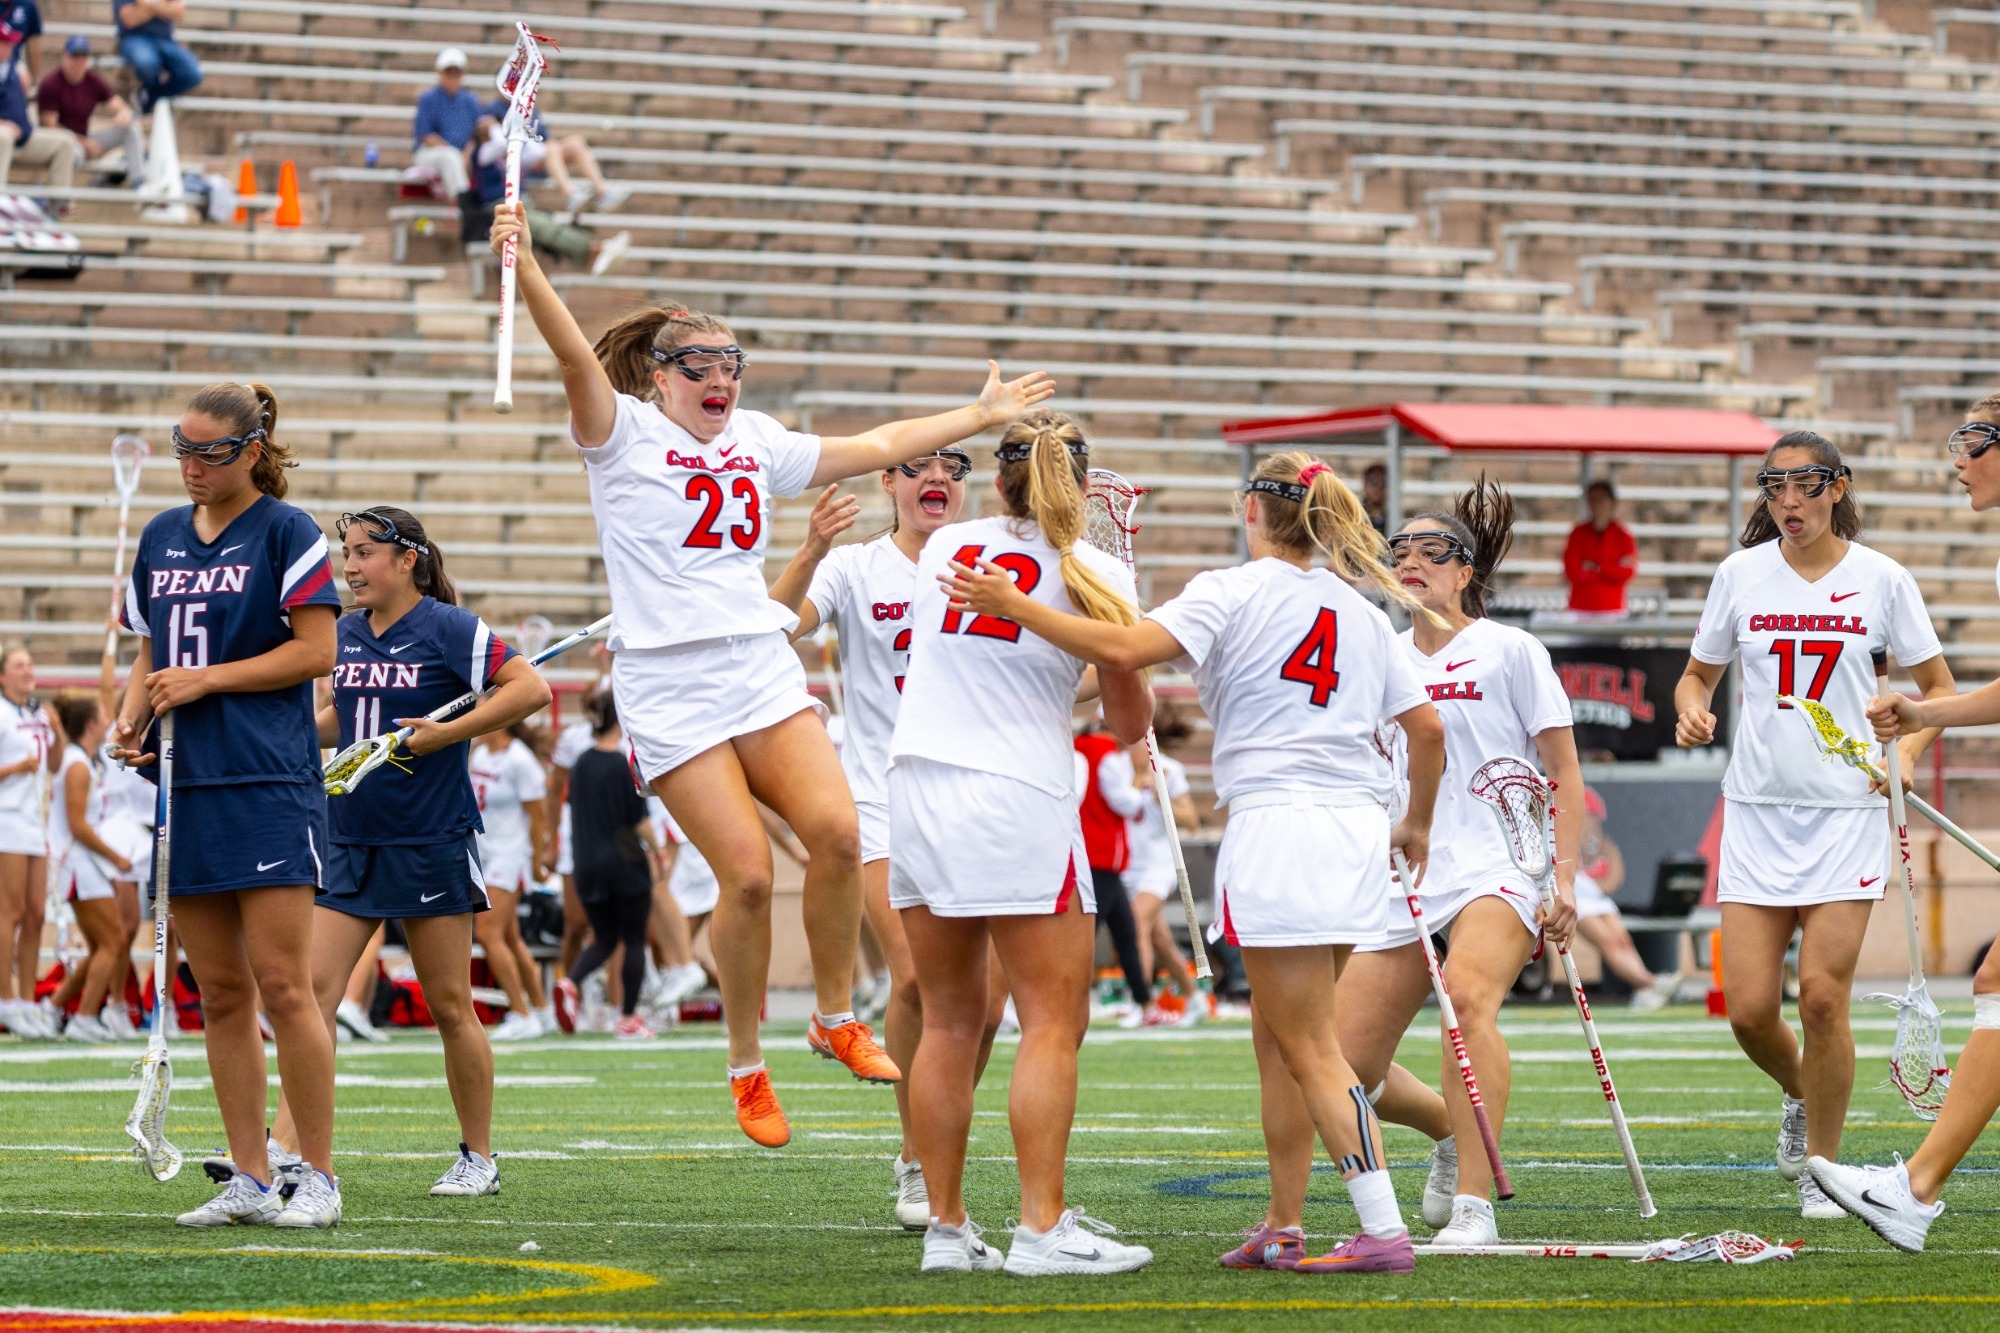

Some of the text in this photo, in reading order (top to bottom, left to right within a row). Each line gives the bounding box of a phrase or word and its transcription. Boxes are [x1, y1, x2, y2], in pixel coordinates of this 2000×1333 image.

[1256, 481, 1281, 491] STX
[681, 474, 762, 551] 23
[400, 538, 417, 549] GAIT
[150, 564, 251, 599] PENN
[940, 545, 1042, 645] 12
[168, 602, 209, 671] 15
[1749, 614, 1868, 636] CORNELL
[1280, 606, 1340, 709] 4
[1768, 638, 1844, 710] 17
[332, 662, 423, 689] PENN
[1554, 661, 1656, 724] NELL
[354, 696, 380, 743] 11
[449, 694, 474, 714] GAIT
[156, 921, 164, 956] GAIT
[1448, 1027, 1471, 1060] BIG
[1601, 1078, 1616, 1102] RE
